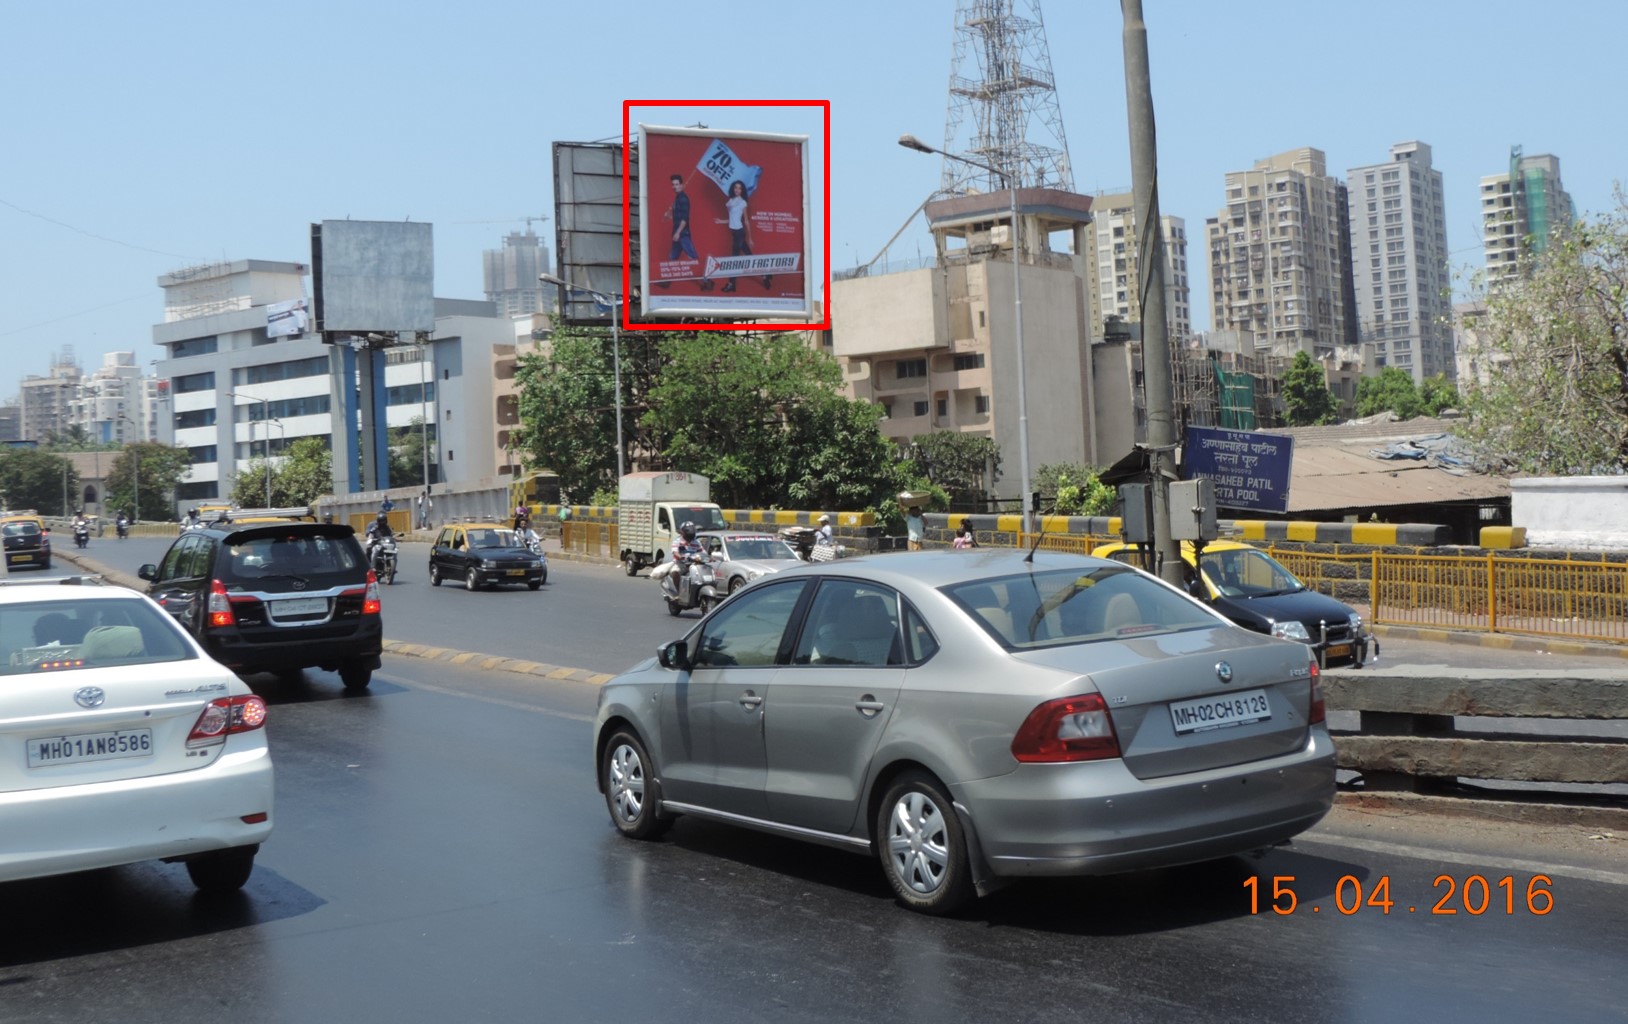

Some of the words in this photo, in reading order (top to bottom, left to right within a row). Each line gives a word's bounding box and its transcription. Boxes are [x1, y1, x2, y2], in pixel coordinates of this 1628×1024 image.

[706, 159, 732, 181] OFF
[719, 258, 751, 271] BRAND
[752, 257, 795, 268] FACTORY
[1251, 442, 1277, 455] पाटील
[1241, 454, 1259, 469] पूल
[1246, 478, 1274, 490] PATIL
[1236, 489, 1260, 501] POOL
[39, 734, 150, 760] MH01AN8586
